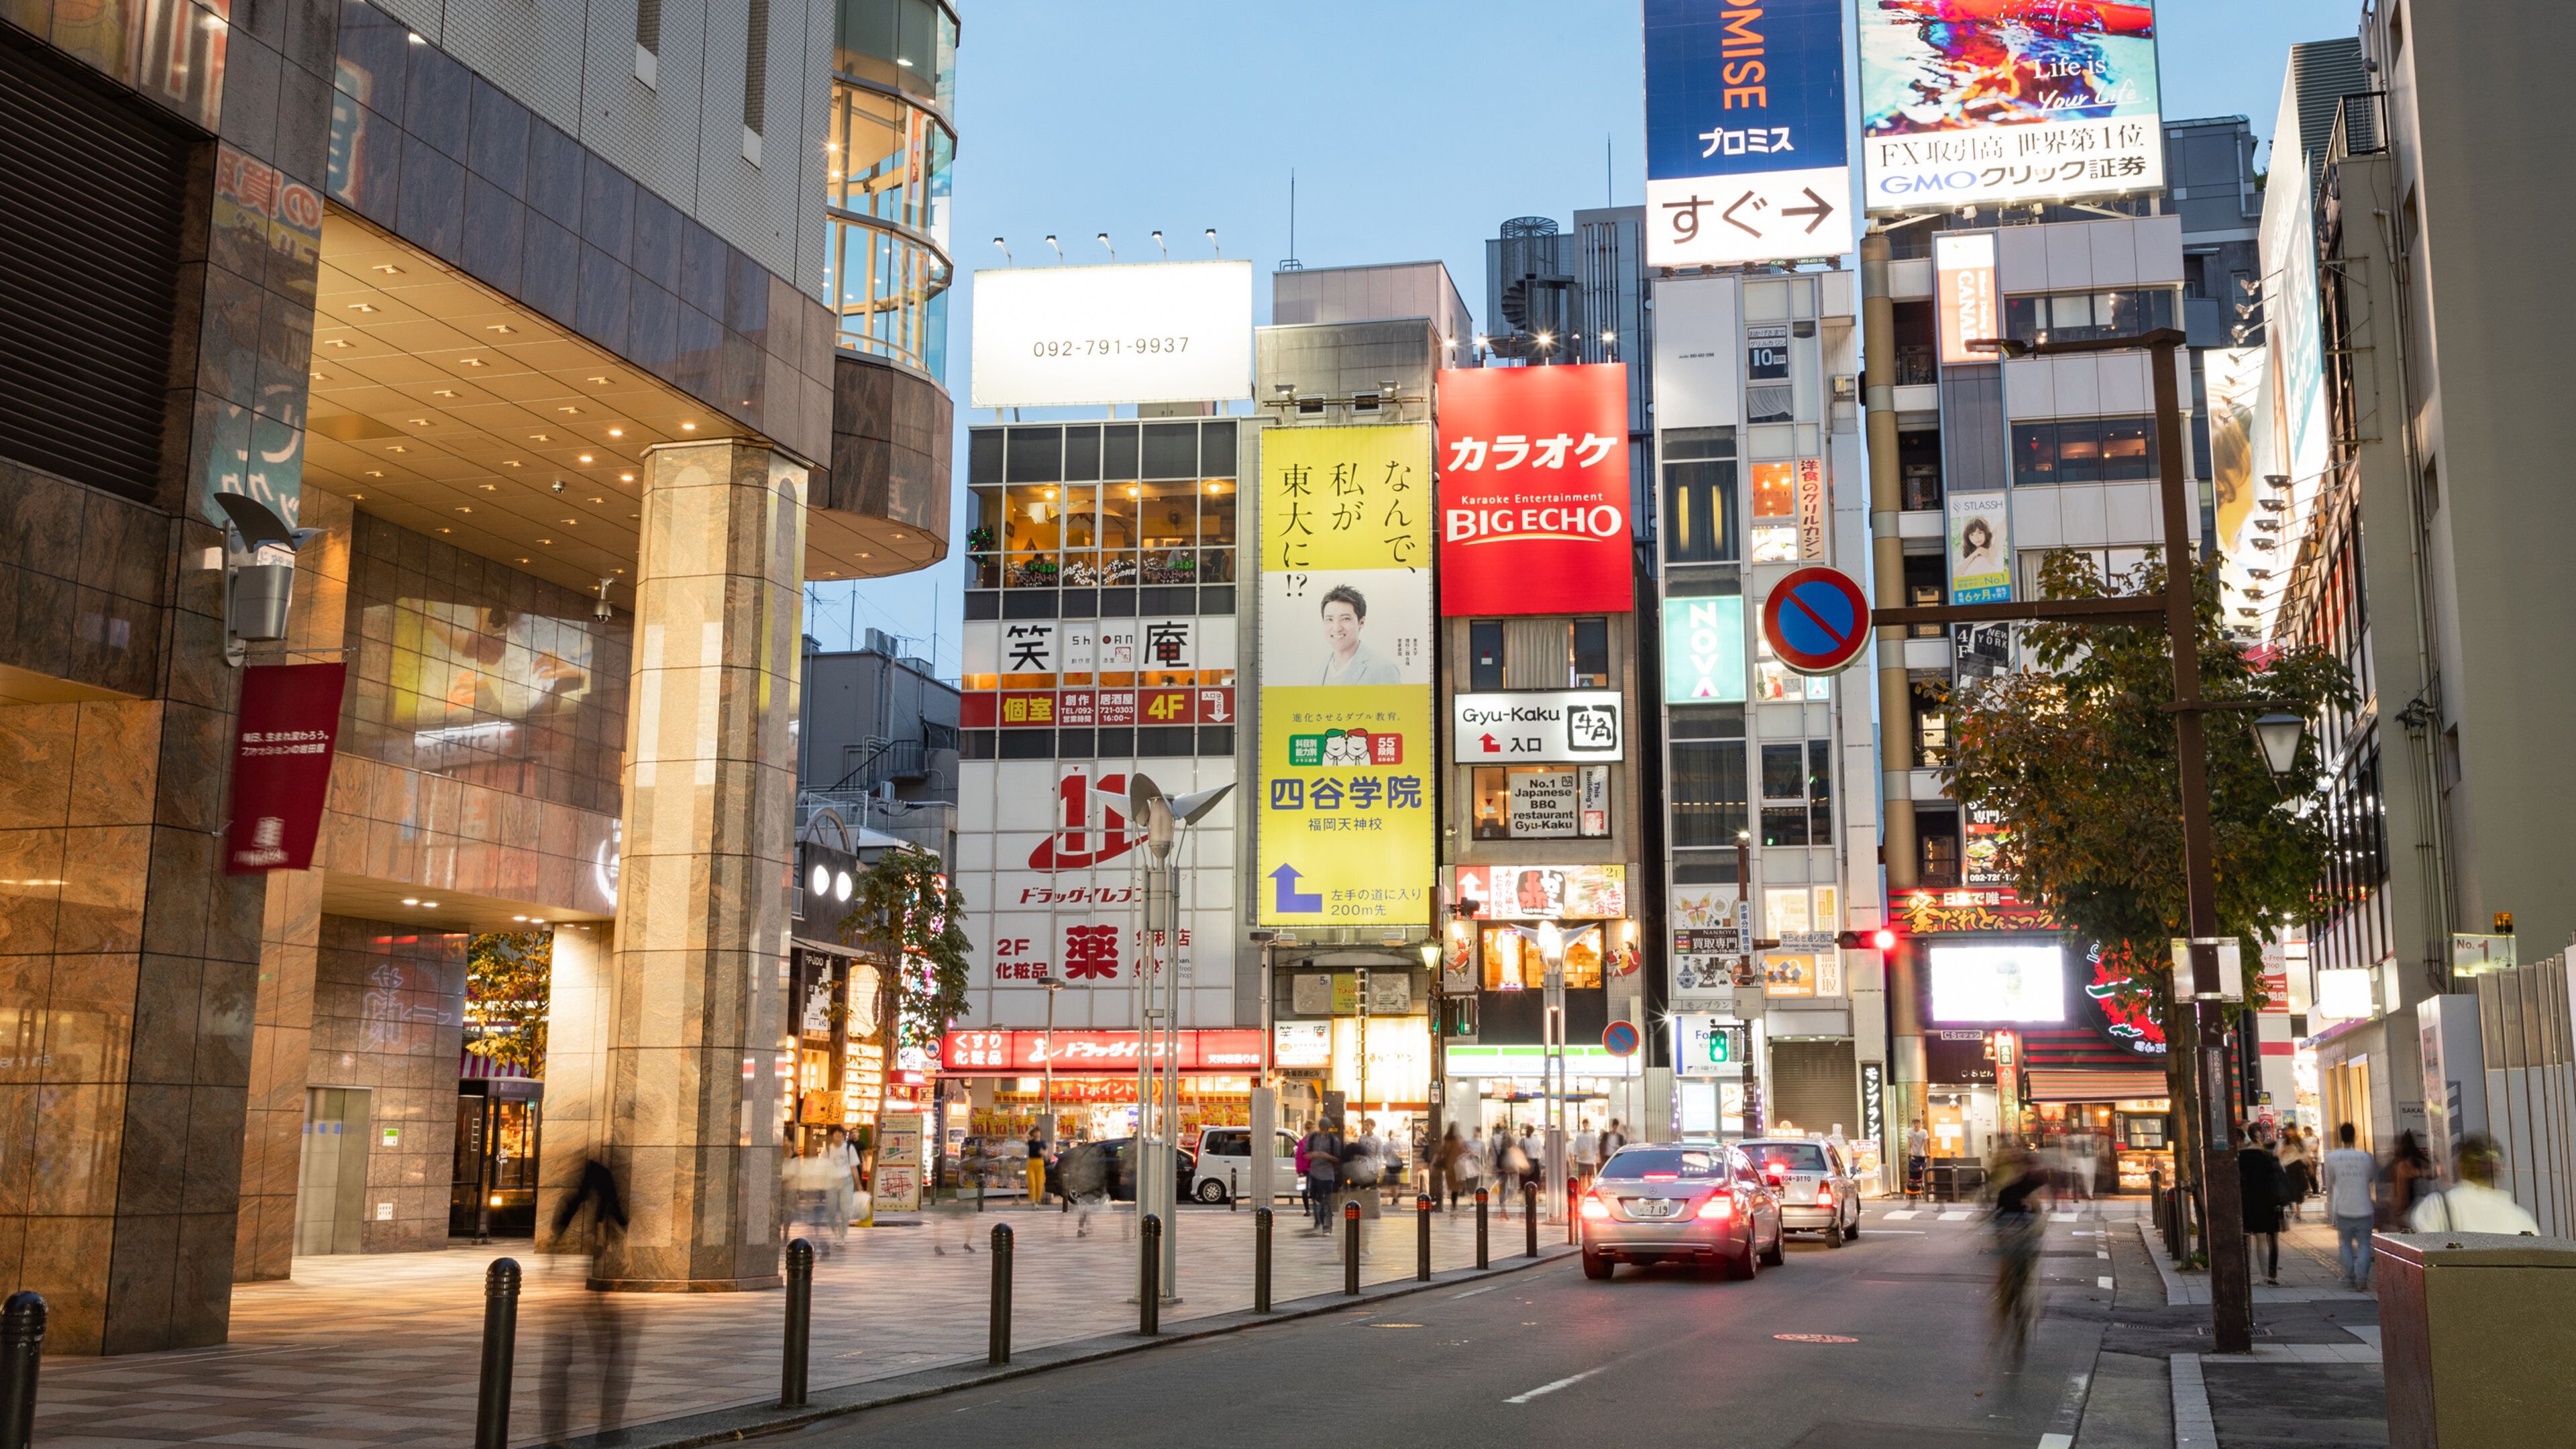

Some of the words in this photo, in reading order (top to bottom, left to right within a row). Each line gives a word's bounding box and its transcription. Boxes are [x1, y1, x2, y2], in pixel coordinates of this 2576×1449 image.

[1721, 0, 1766, 109] MISE
[2033, 58, 2081, 78] Life
[2088, 55, 2106, 74] is
[2039, 91, 2089, 115] Your
[1699, 127, 1794, 158] プロミス
[1881, 136, 2003, 167] FX取引高
[2019, 124, 2144, 157] 世界第1位
[1880, 156, 2146, 194] GMOクリック証券
[1662, 190, 1768, 245] すぐ
[1033, 337, 1190, 358] 092-791-9937
[1754, 349, 1772, 366] 10
[1448, 433, 1618, 472] カラオケ
[1329, 462, 1365, 531] 私が
[1462, 494, 1509, 504] Karaoke
[1515, 492, 1603, 503] Entertainment
[1801, 460, 1819, 558] 洋食のグリルカジン
[1964, 500, 2003, 511] STLASSH
[1384, 460, 1416, 574] なんで、
[1446, 509, 1514, 542] BIG
[1522, 505, 1622, 537] ECHO
[1978, 634, 2008, 649] YORK
[1986, 628, 2007, 639] NEW
[1006, 625, 1052, 671] 笑
[1144, 621, 1189, 667] 庵
[1689, 602, 1721, 697] NOVA
[1004, 697, 1053, 722] 個室
[1148, 695, 1185, 720] 4F
[1463, 707, 1560, 725] Gyu-Kaku
[1292, 712, 1401, 722] 進化させるダブル教育。
[1574, 714, 1612, 741] 牛角
[1295, 739, 1318, 748] 科目別
[1510, 737, 1542, 752] 入口
[1295, 748, 1318, 757] 能力別
[1529, 779, 1556, 788] No.1
[1271, 775, 1422, 810] 四谷学院
[1515, 788, 1572, 799] Japanese
[1530, 800, 1556, 809] BBQ
[1513, 810, 1574, 819] restaurant
[1308, 818, 1383, 831] 福岡天神校
[1515, 820, 1572, 831] Gyu-Kaku
[1331, 889, 1421, 900] 左手の道に入り
[1331, 904, 1387, 916] 200m先
[1740, 904, 1750, 952] 歩車分離信号
[998, 939, 1030, 956] 2F
[1065, 924, 1119, 980] 薬
[1693, 937, 1739, 950] 買取専門
[2457, 939, 2475, 950] No.
[2478, 940, 2489, 963] 1
[996, 962, 1048, 979] 化粧品
[1686, 1001, 1729, 1009] モンブラン
[955, 1034, 1002, 1046] くすり
[954, 1050, 1002, 1065] 化粧品
[1077, 1083, 1135, 1095] Tポイント
